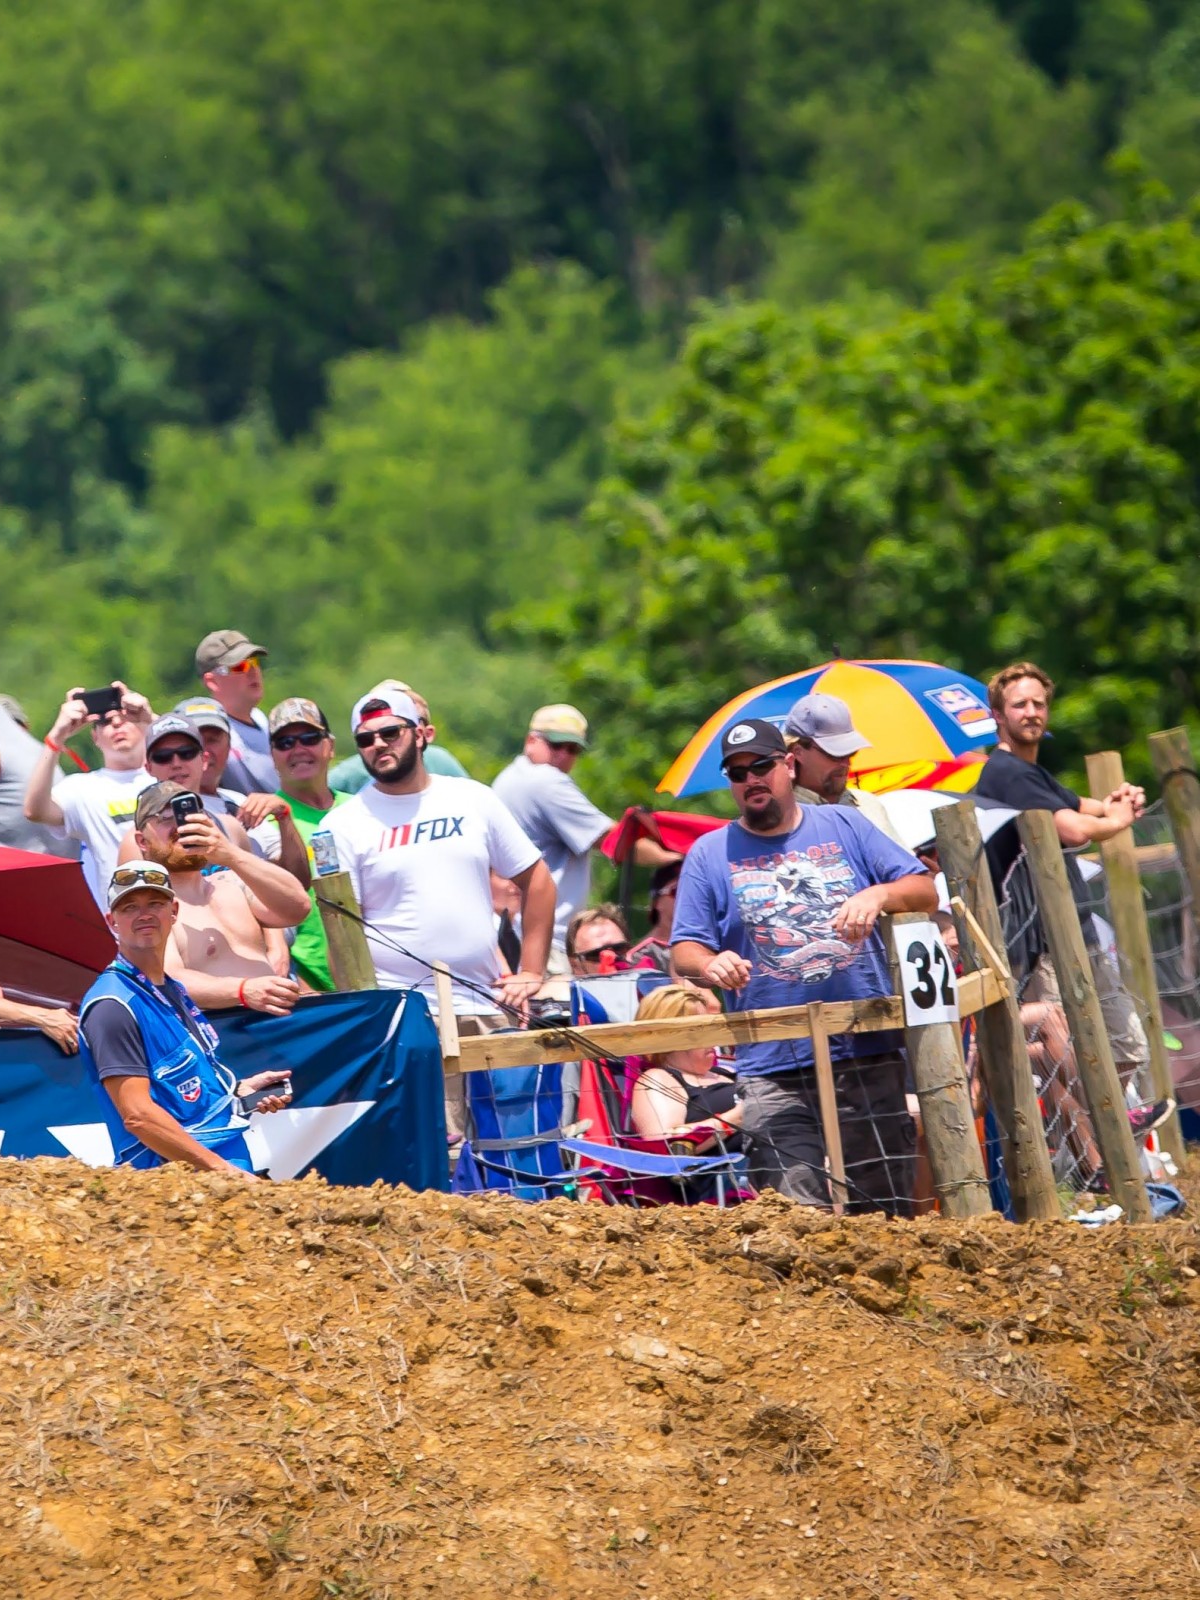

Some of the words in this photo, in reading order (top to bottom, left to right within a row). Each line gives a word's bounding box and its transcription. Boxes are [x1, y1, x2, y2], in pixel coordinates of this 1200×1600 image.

[414, 816, 465, 844] FOX
[806, 841, 842, 860] OIL
[906, 940, 955, 1010] 32
